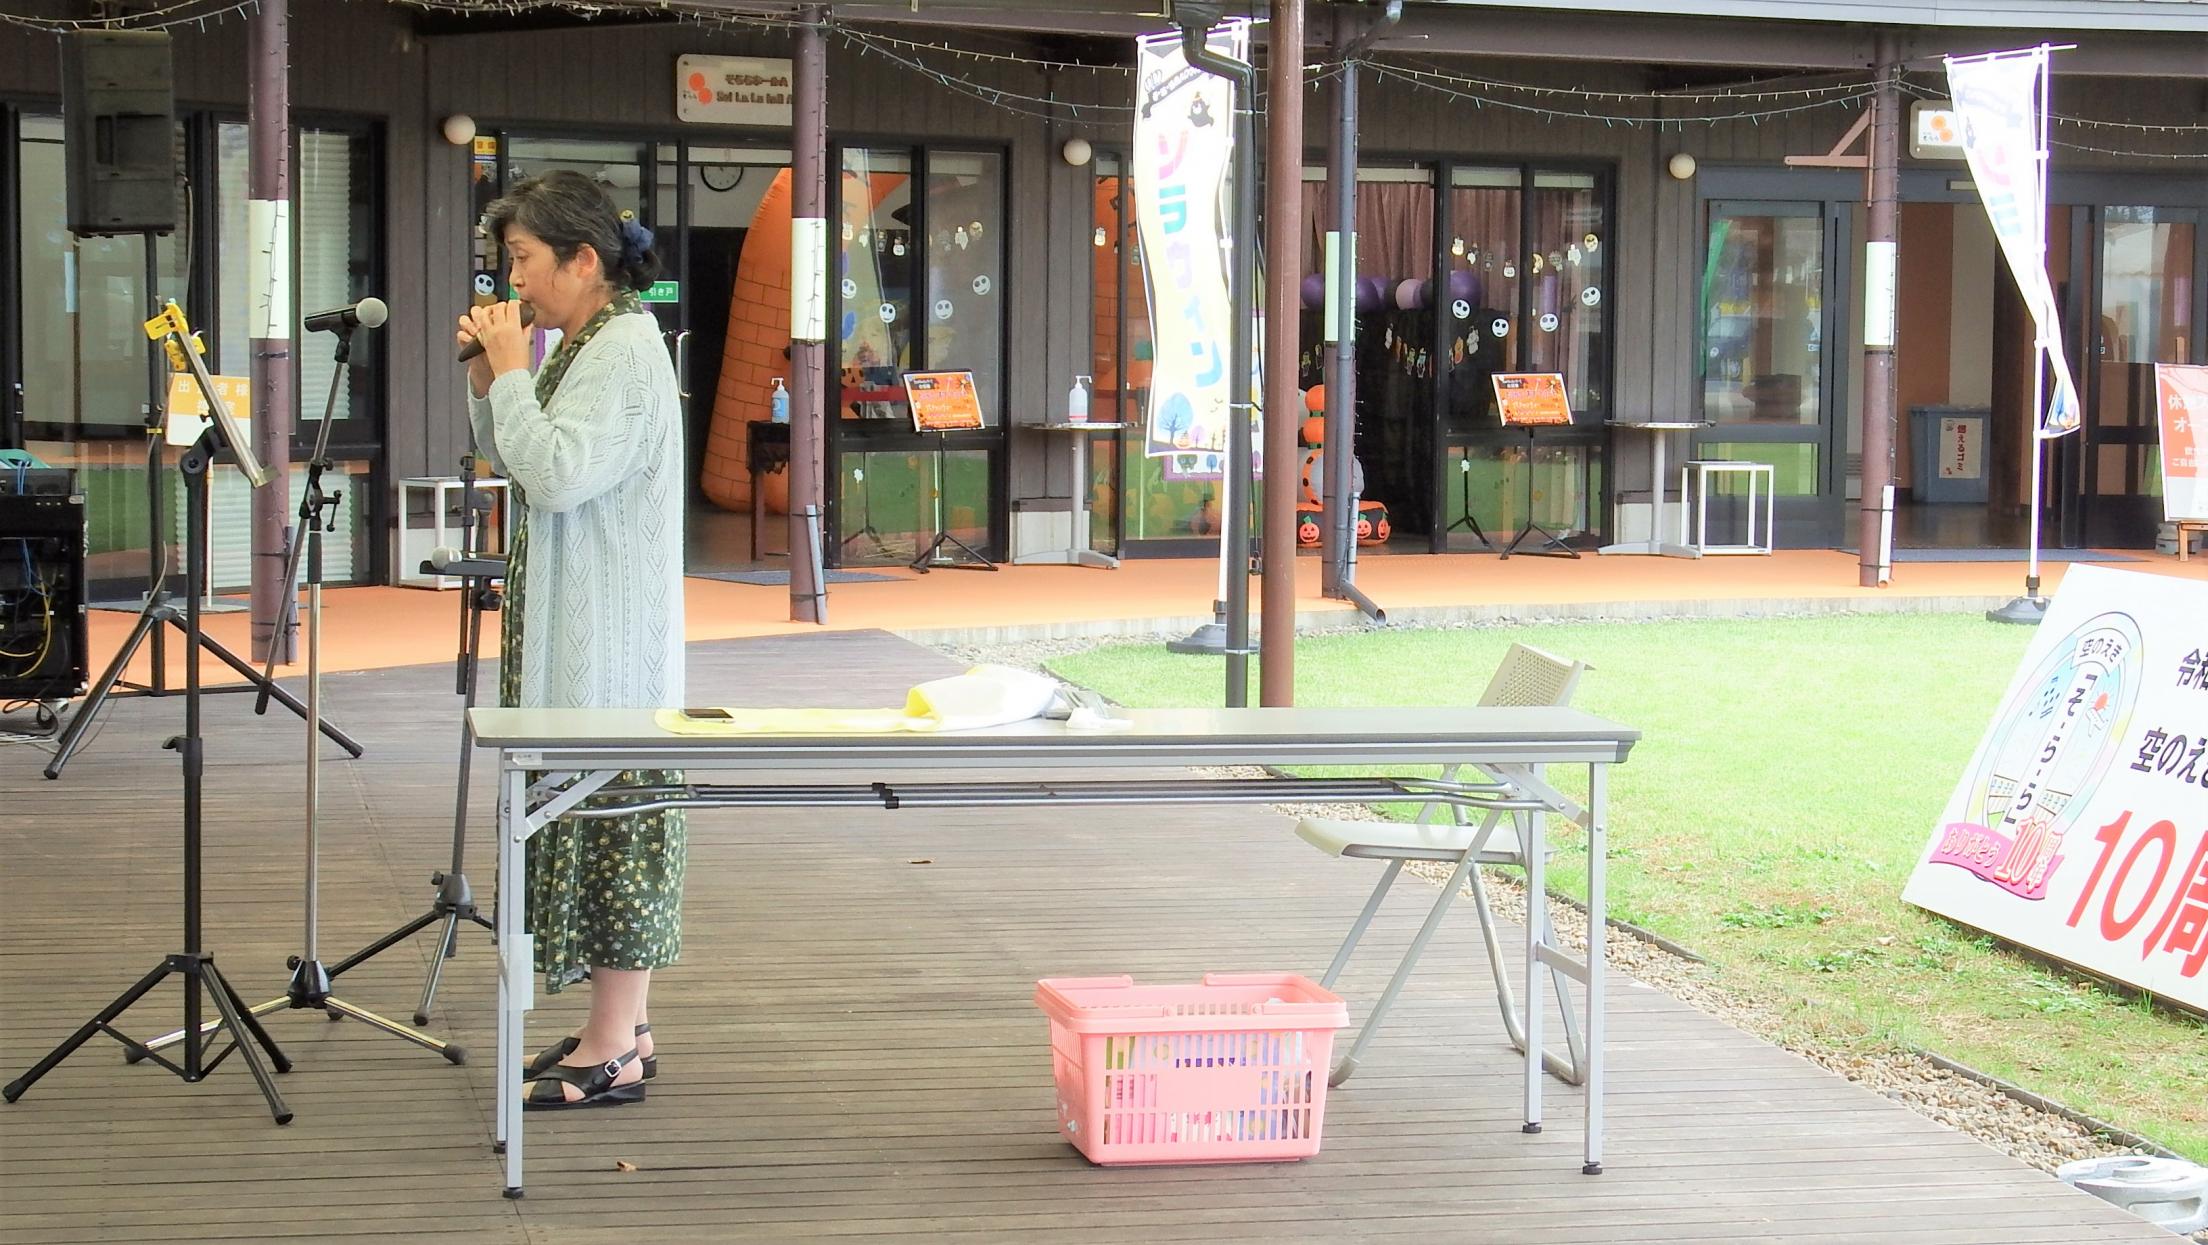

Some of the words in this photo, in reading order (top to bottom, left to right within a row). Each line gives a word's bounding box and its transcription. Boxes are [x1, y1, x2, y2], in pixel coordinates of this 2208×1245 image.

[178, 380, 249, 397] 出者様
[2079, 638, 2123, 663] 空のえき
[2130, 727, 2208, 788] 空のえ
